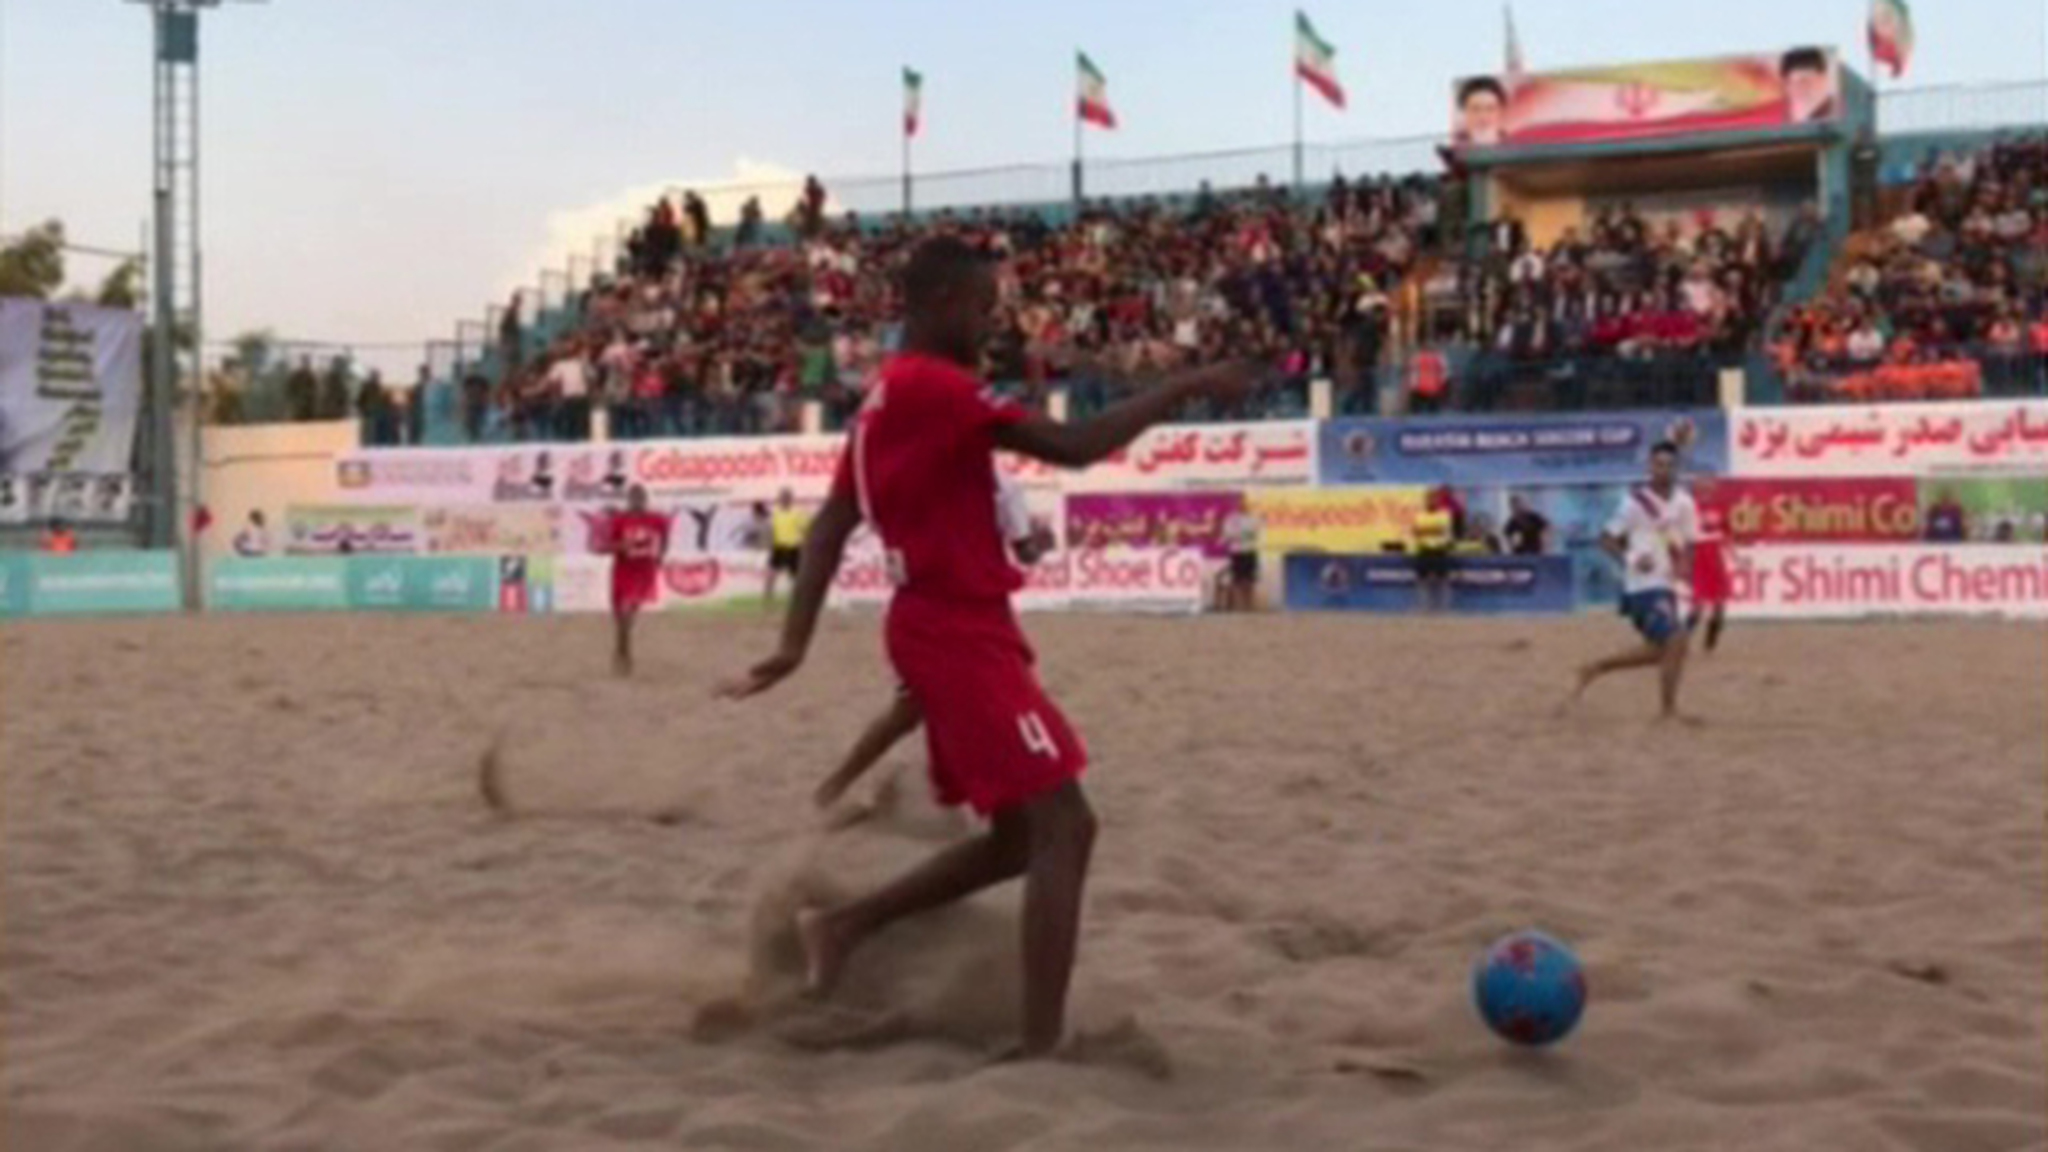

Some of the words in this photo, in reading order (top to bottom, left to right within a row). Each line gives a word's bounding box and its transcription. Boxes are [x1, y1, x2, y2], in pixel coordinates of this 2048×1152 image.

[1772, 493, 1868, 533] Shimi
[1158, 548, 1199, 587] Co
[1781, 555, 1899, 602] Shimi
[1017, 711, 1060, 760] 4
